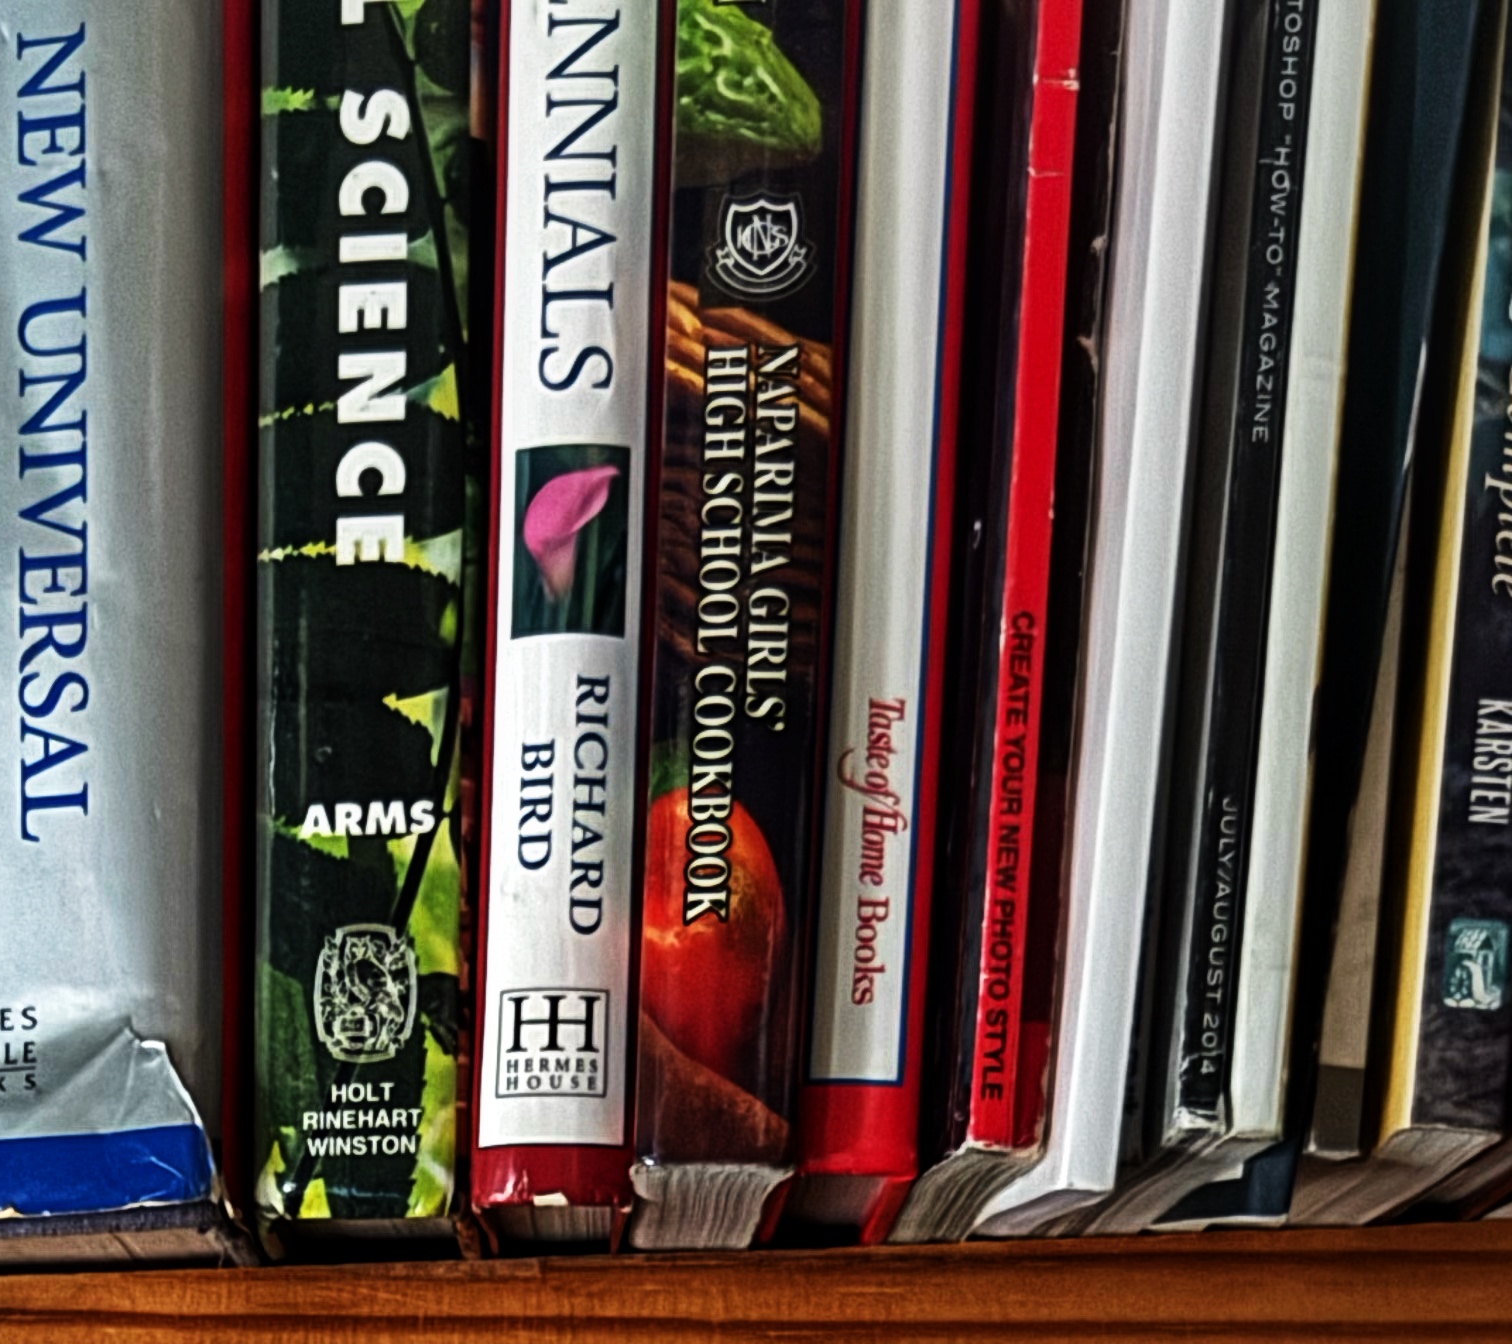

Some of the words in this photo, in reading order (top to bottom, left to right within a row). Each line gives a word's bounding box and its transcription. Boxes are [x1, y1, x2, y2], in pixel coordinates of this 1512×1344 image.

[16, 20, 86, 264] NEW
[335, 88, 410, 566] SCIENCE
[1250, 287, 1282, 444] MAGAZINE
[703, 348, 748, 461] HIGH
[750, 345, 799, 575] NAPARIMA
[17, 286, 90, 843] UNIVERSAL
[696, 472, 745, 654] SCHOOL
[744, 586, 789, 732] GIRLS'
[1005, 610, 1036, 728] CREATE
[864, 696, 907, 768] Taste
[998, 732, 1028, 817] YOUR
[1467, 697, 1512, 825] KARSTEN
[299, 800, 436, 840] ARMS
[517, 739, 556, 872] BIRD
[568, 673, 611, 936] RICHARD
[685, 664, 737, 923] COOKBOOK
[859, 797, 908, 887] Home
[994, 822, 1021, 896] NEW
[1204, 795, 1239, 1005] JULY/AUGUST
[850, 894, 891, 1007] Books
[986, 899, 1018, 1002] PHOTO
[331, 1081, 395, 1103] HOLT
[505, 1057, 599, 1074] HERMES
[505, 1074, 598, 1092] HOUSE
[979, 1006, 1008, 1101] STYLE
[301, 1108, 423, 1132] RINEHART
[306, 1134, 418, 1157] WINSTON
